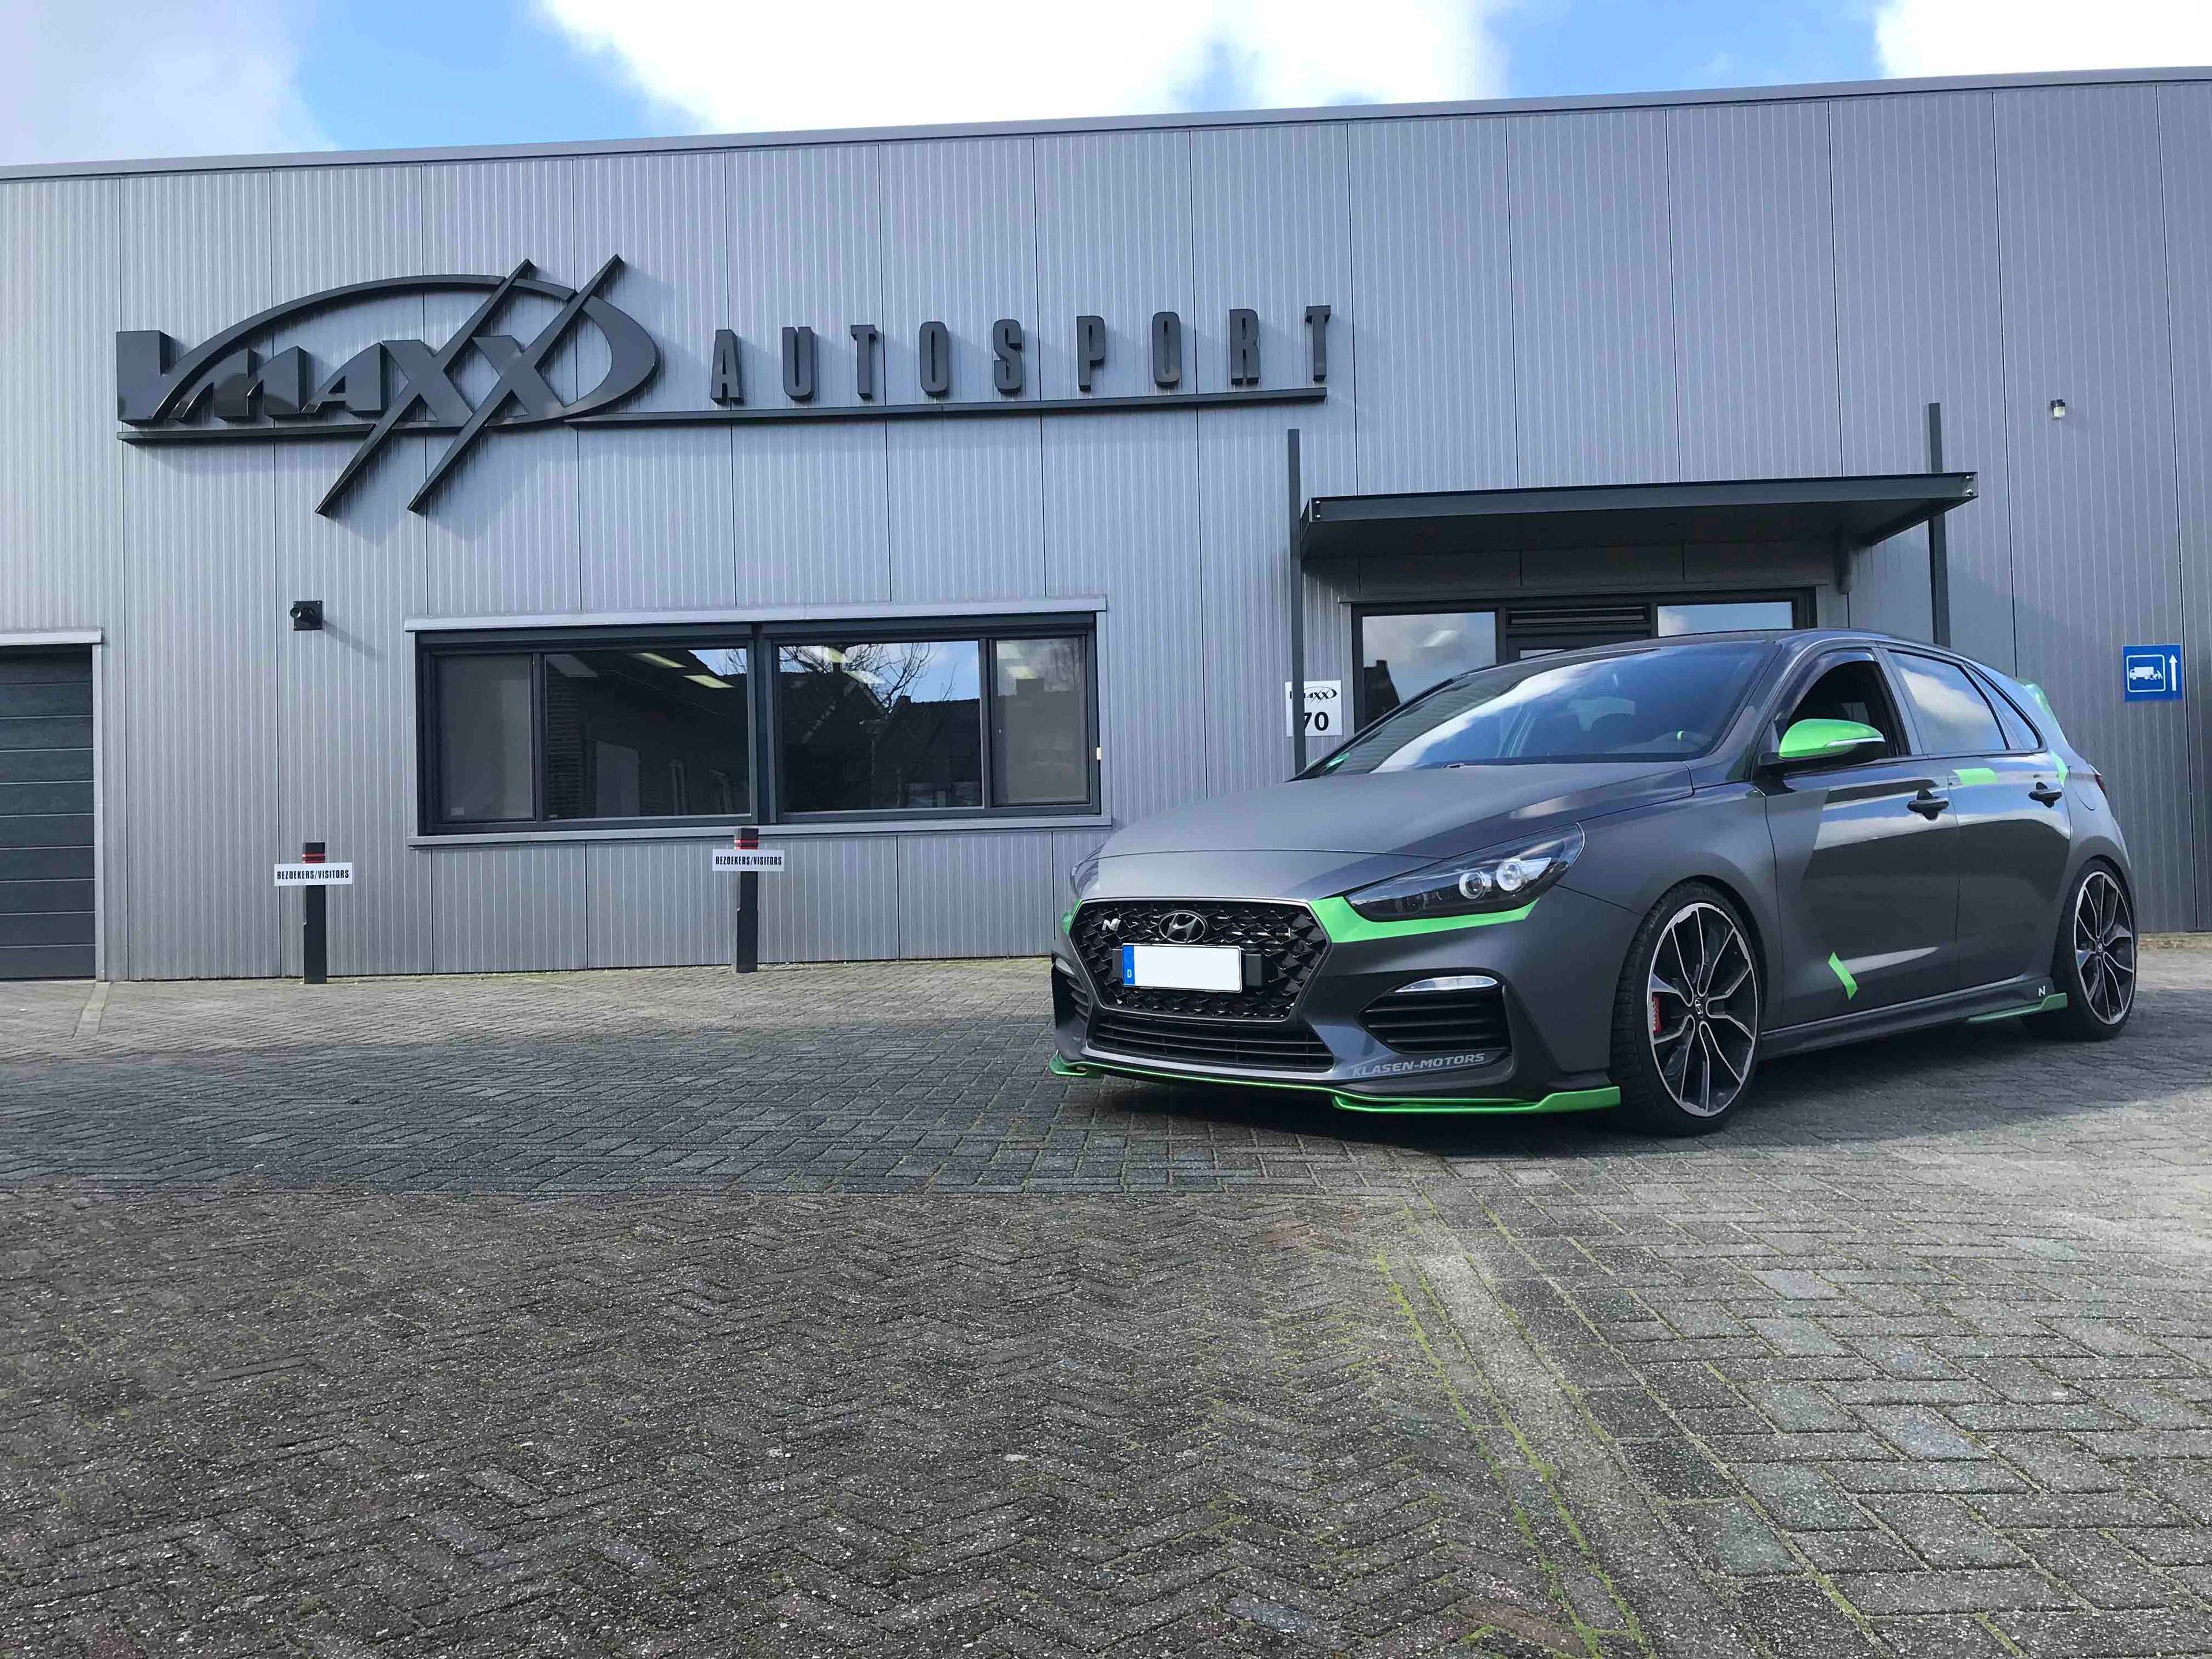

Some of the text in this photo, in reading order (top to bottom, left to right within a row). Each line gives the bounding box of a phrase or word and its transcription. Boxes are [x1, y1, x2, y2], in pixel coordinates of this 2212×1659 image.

[710, 305, 1331, 405] AUTOSPORT
[1304, 711, 1329, 731] 70
[1127, 969, 1132, 978] D
[2038, 985, 2046, 997] N
[1353, 1053, 1485, 1077] KLASEN-MOTORS
